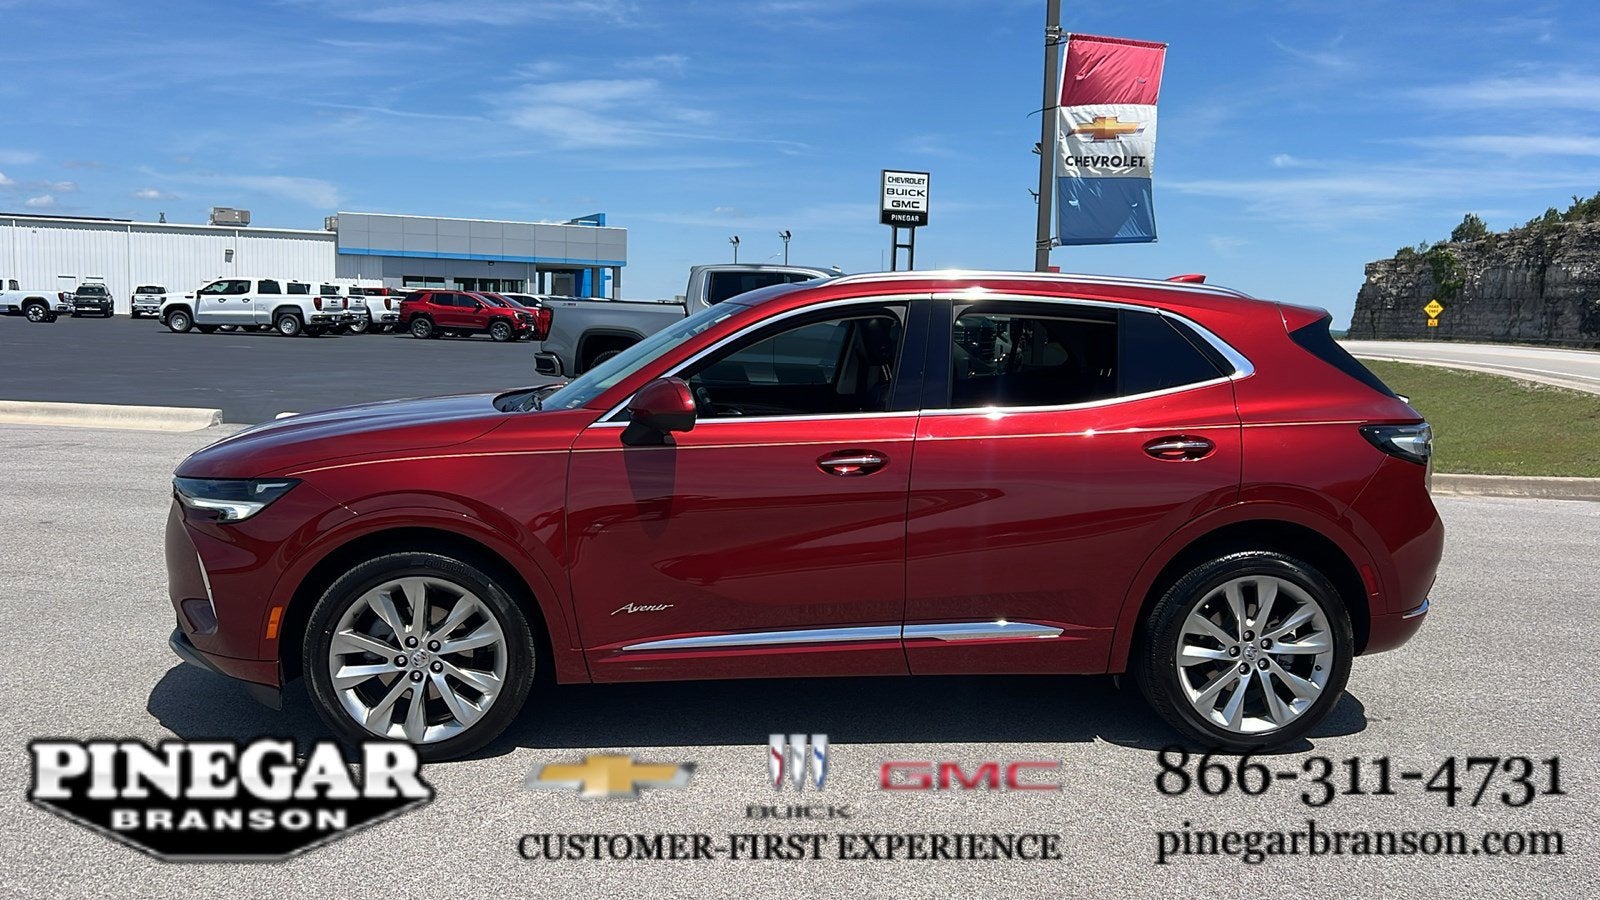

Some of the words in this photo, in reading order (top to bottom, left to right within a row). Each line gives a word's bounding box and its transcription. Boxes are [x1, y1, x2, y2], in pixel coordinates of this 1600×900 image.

[1065, 155, 1145, 168] CHEVROLET
[888, 176, 925, 185] CHEVROLET
[886, 188, 926, 197] BUICK
[892, 200, 920, 209] GMC
[891, 214, 920, 222] PINEGAR
[611, 602, 674, 616] Avenir
